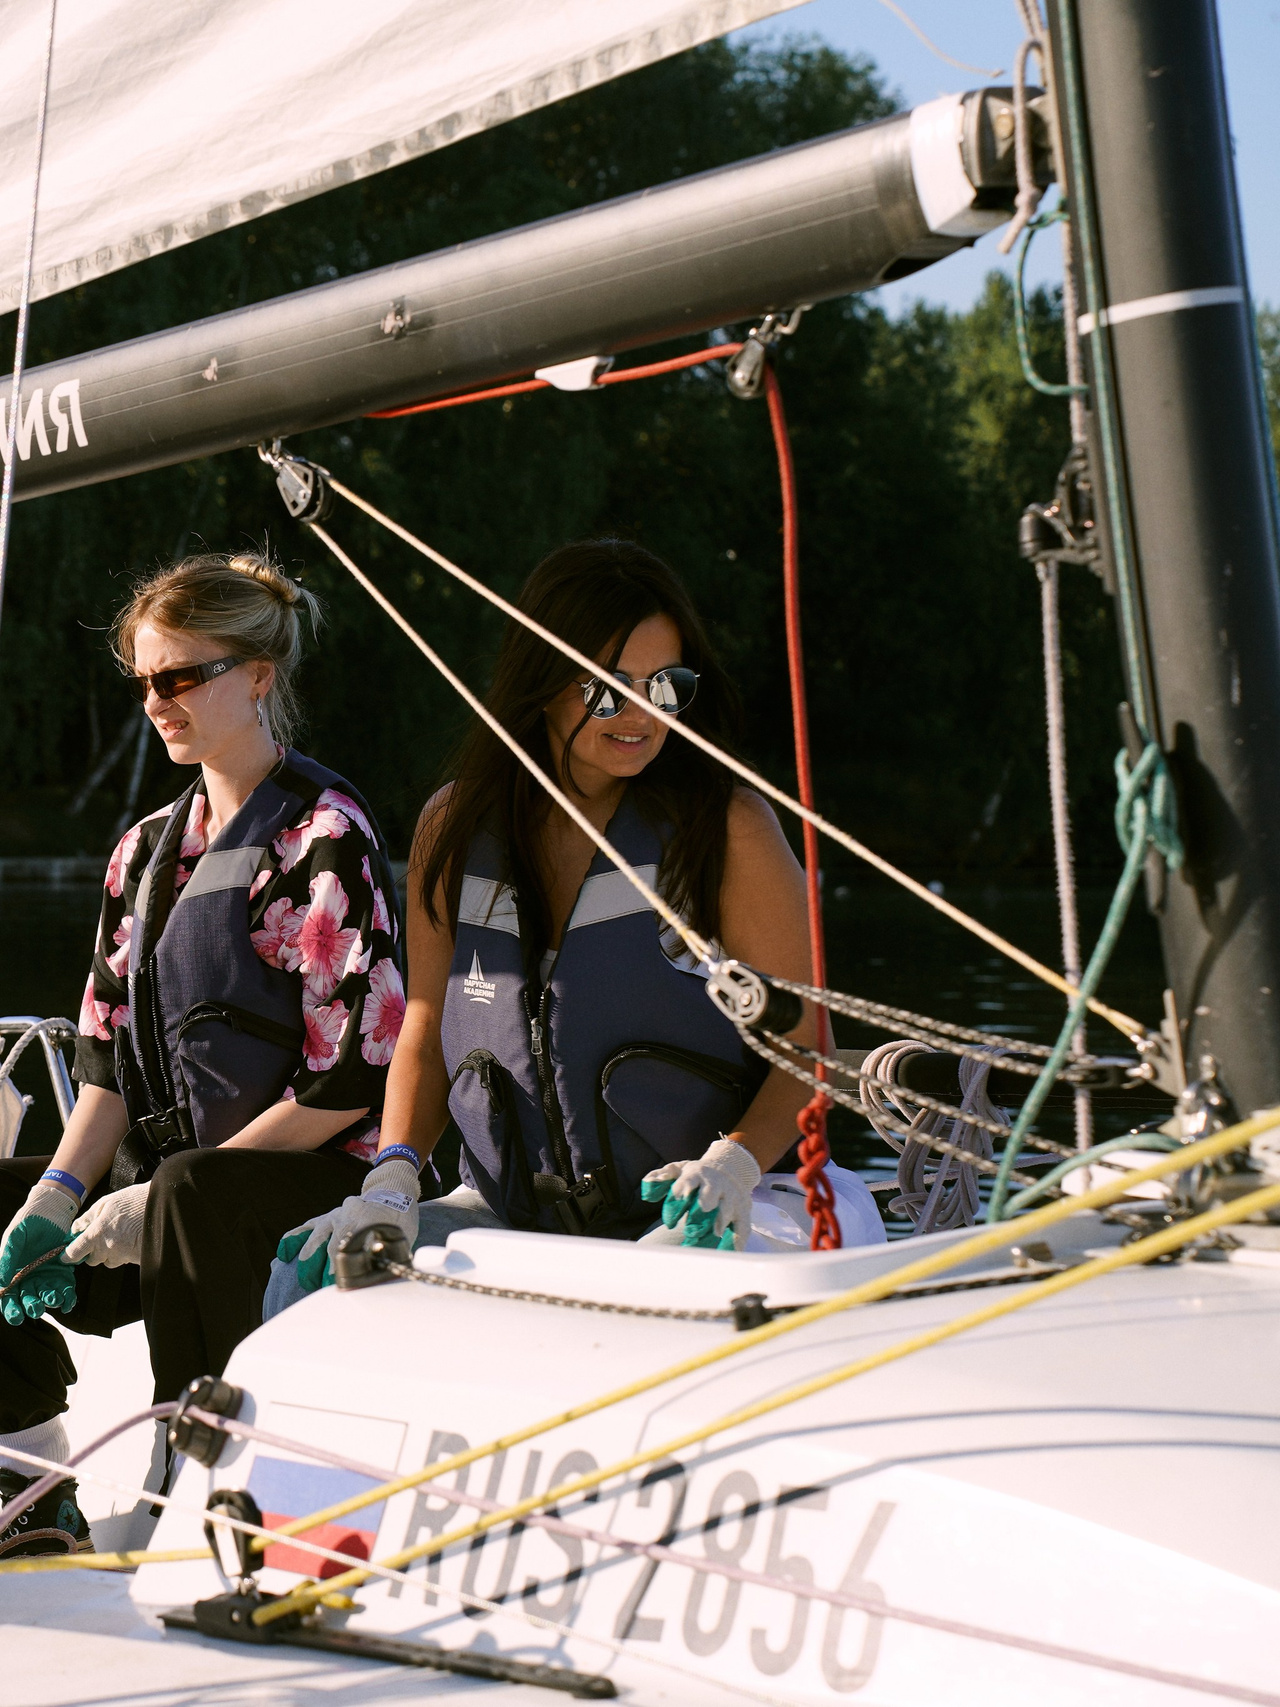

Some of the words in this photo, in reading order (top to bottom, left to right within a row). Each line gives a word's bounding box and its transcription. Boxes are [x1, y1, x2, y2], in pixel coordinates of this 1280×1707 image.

[379, 1146, 420, 1167] ПАРУСНА
[387, 1429, 600, 1630] RUS
[612, 1456, 898, 1694] 2856
